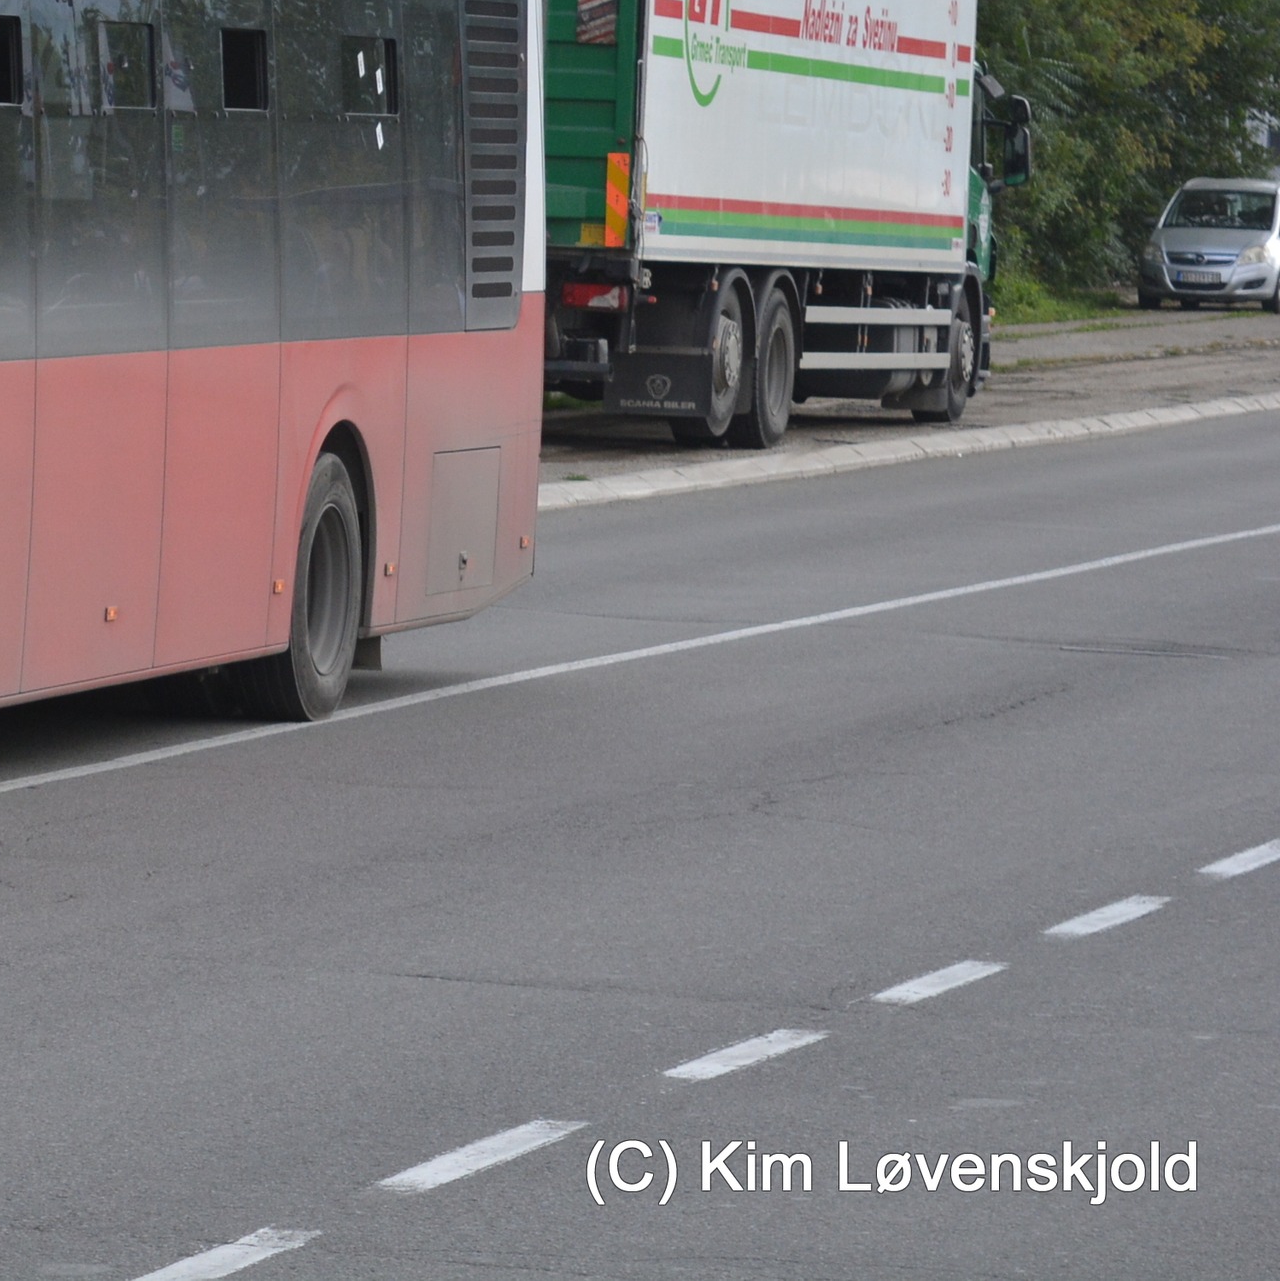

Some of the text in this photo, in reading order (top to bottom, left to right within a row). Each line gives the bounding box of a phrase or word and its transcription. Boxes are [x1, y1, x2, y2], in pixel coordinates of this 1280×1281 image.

[846, 15, 859, 48] za
[715, 36, 747, 73] Transport
[620, 399, 661, 408] SCANIA
